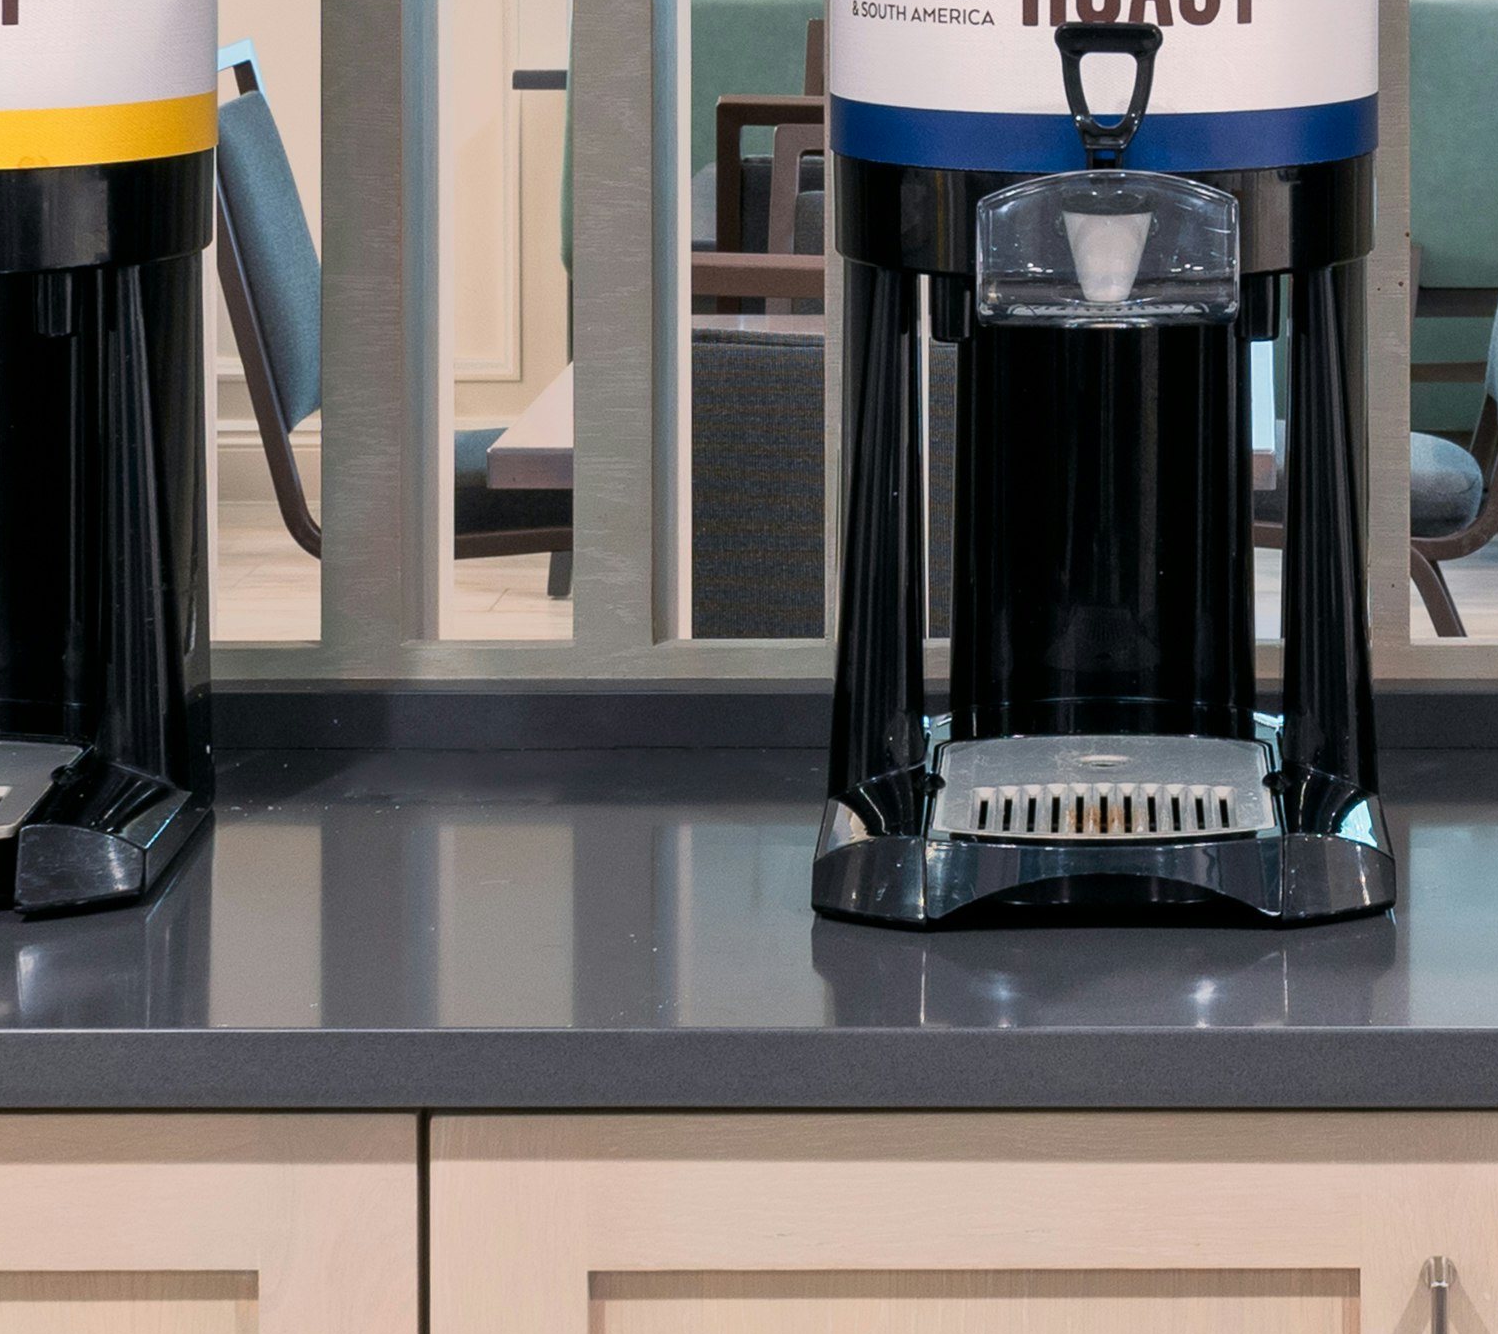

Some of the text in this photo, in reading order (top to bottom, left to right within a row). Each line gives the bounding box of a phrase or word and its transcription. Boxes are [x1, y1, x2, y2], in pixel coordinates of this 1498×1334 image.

[852, 0, 995, 26] & SOUTH AMERICA
